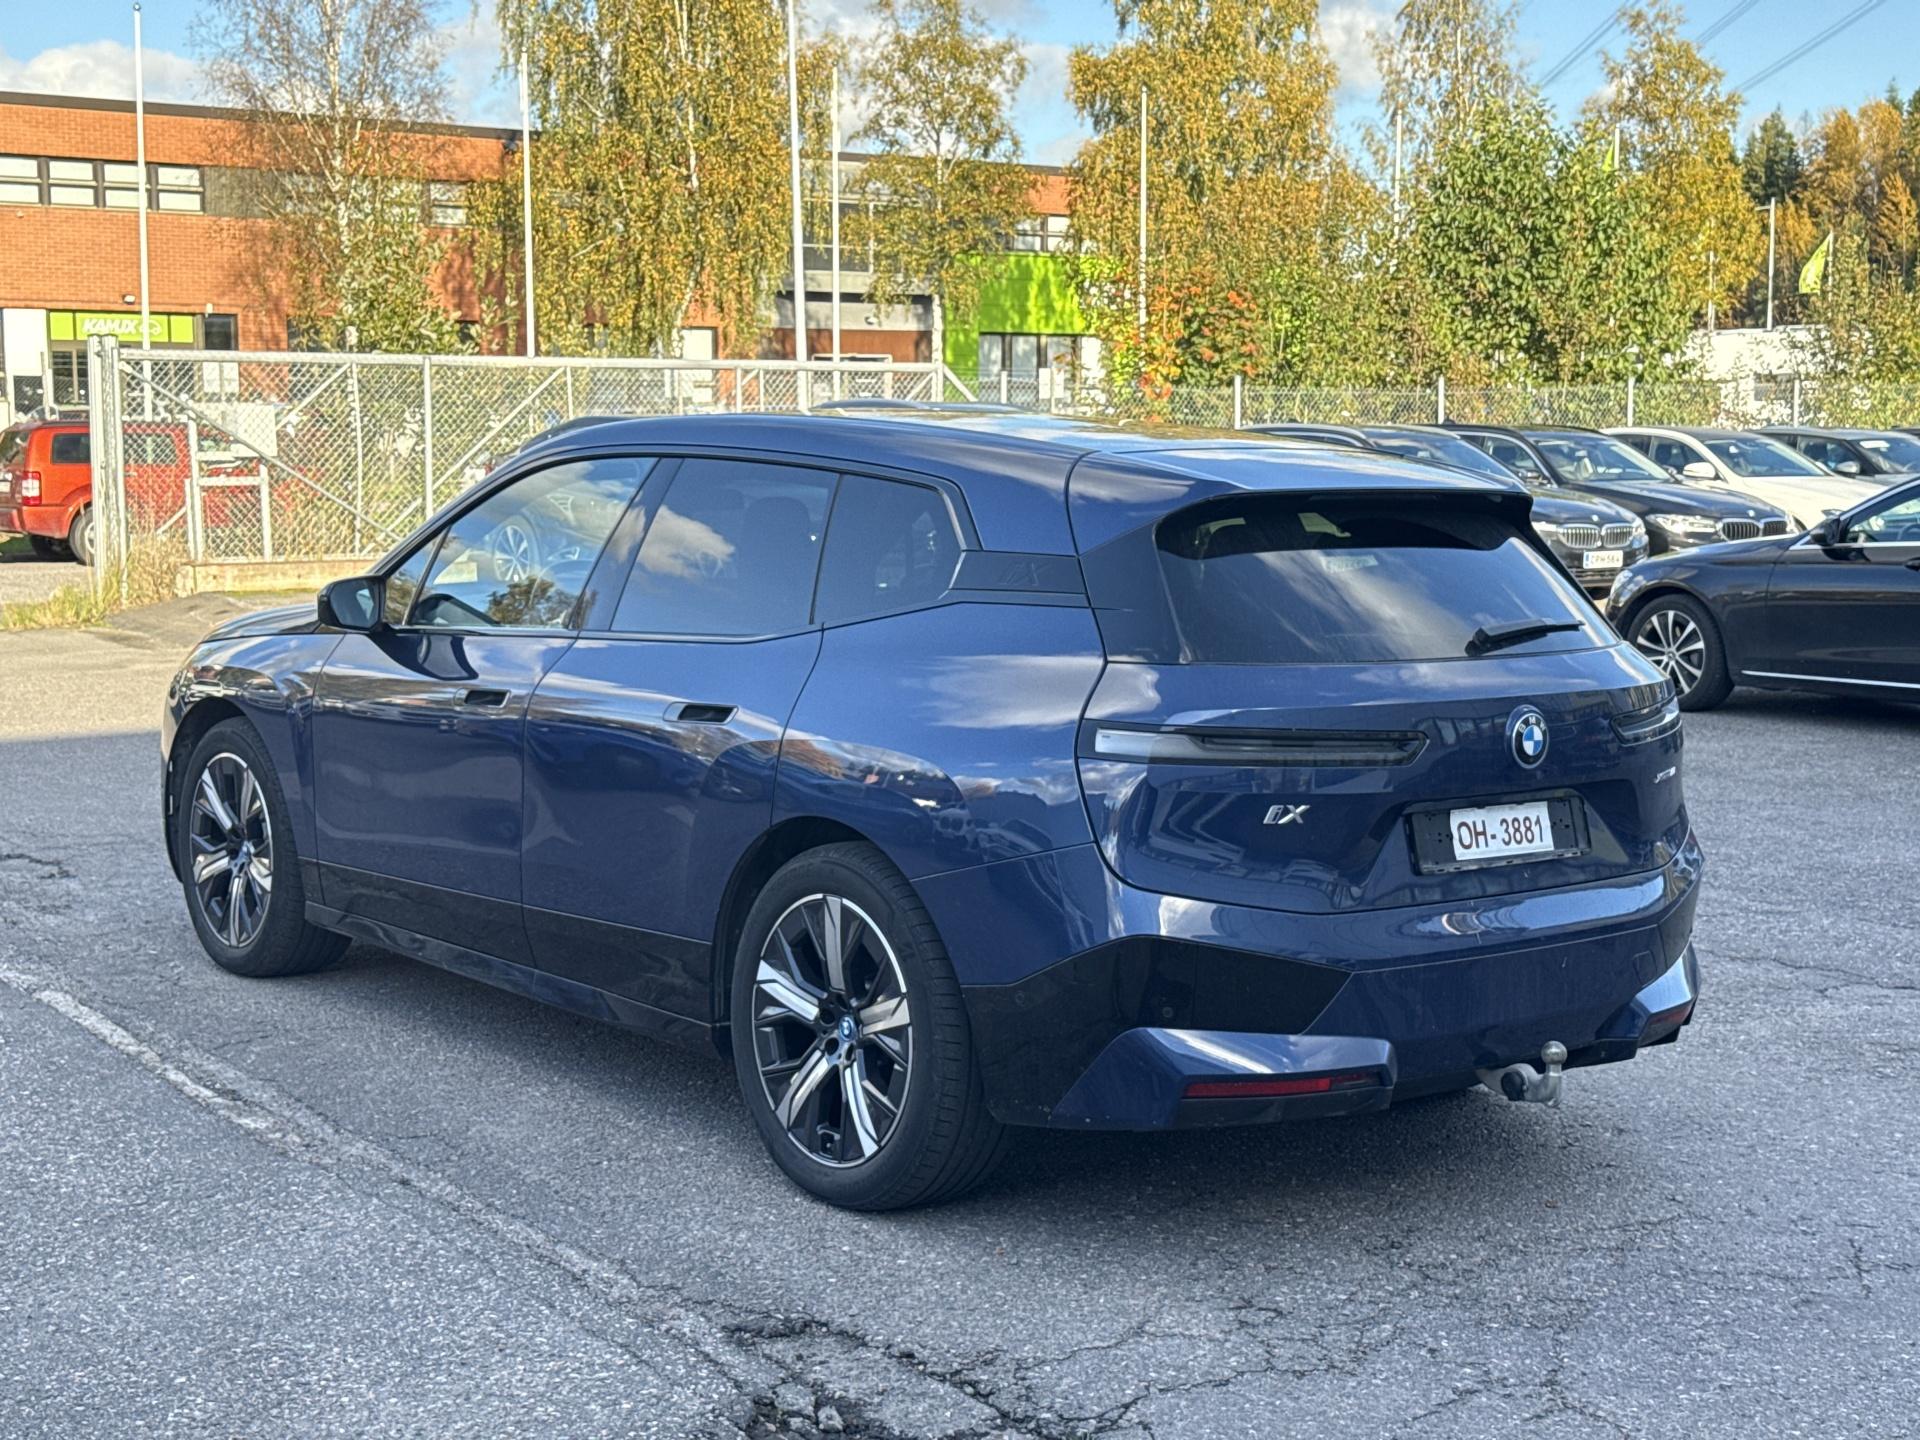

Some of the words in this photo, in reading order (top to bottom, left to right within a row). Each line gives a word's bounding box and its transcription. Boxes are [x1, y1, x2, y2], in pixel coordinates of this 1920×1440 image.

[82, 318, 138, 335] KAMUX
[1519, 716, 1547, 733] BMW
[1457, 815, 1543, 850] OH-3881
